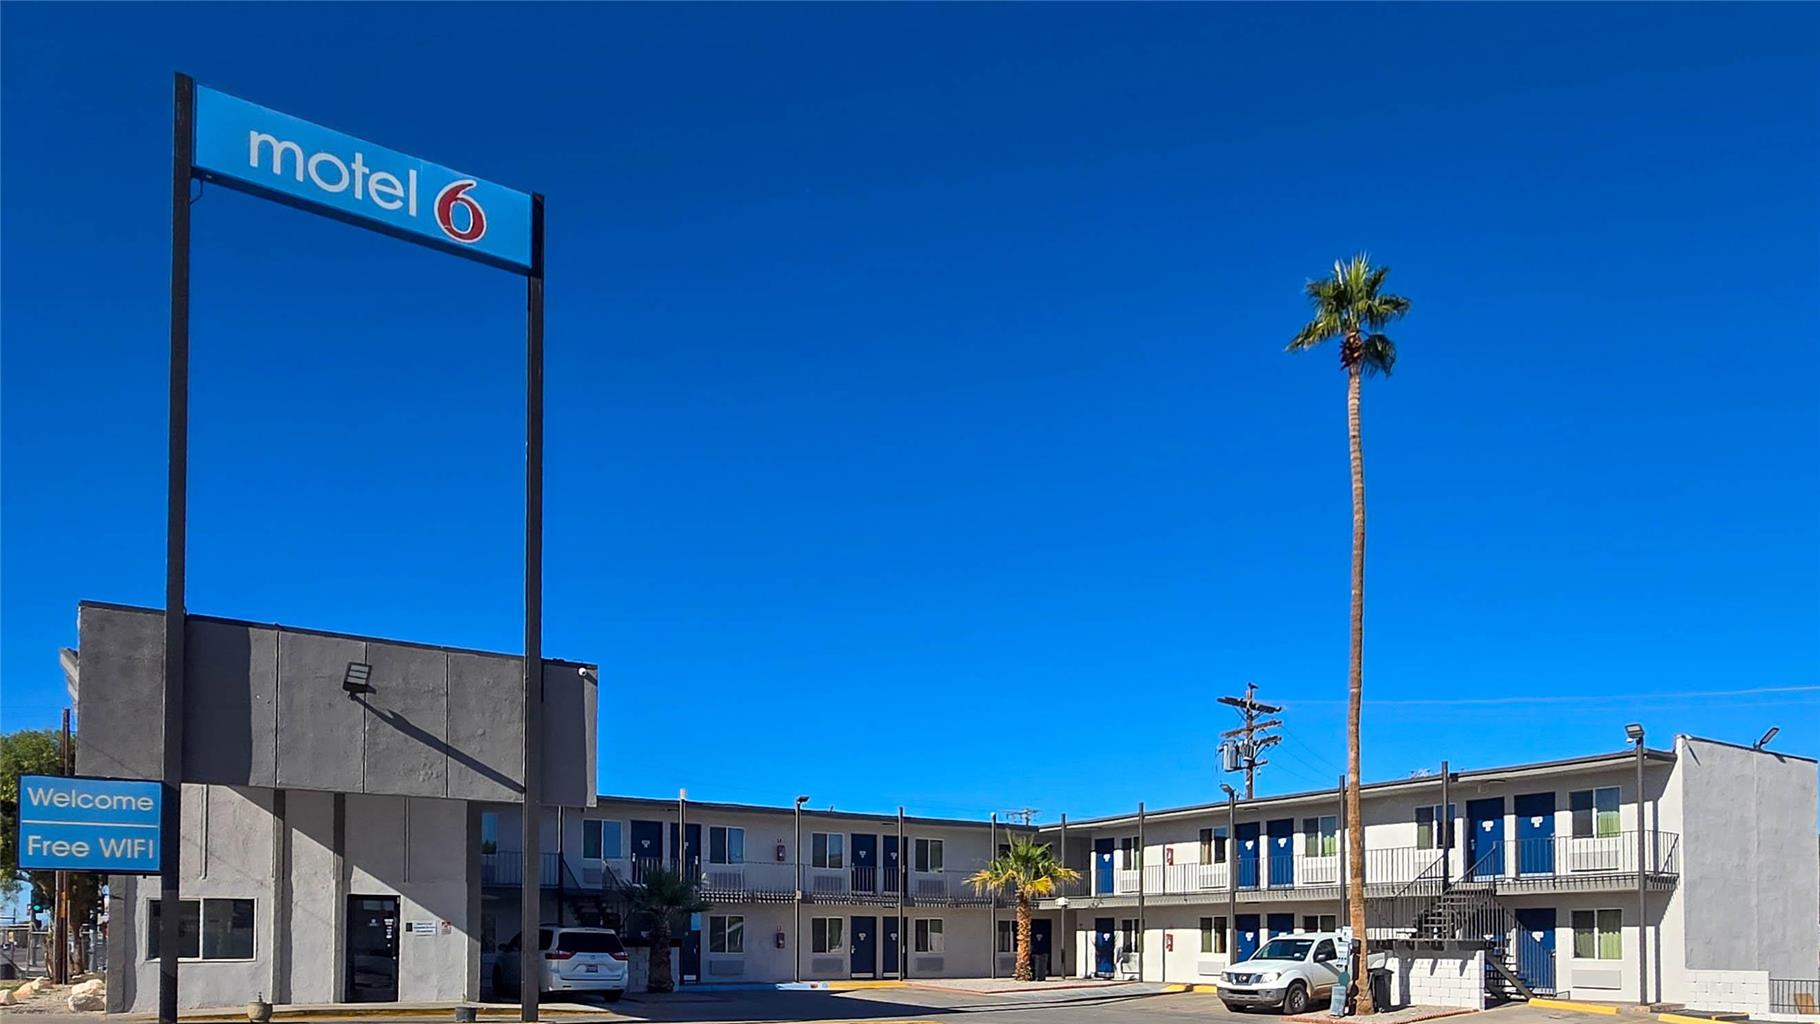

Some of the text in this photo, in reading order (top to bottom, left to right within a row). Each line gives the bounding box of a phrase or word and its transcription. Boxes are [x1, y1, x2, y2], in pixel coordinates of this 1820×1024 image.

[249, 130, 487, 243] motel 6
[27, 787, 154, 811] Welcome
[27, 835, 153, 859] Free WIFI
